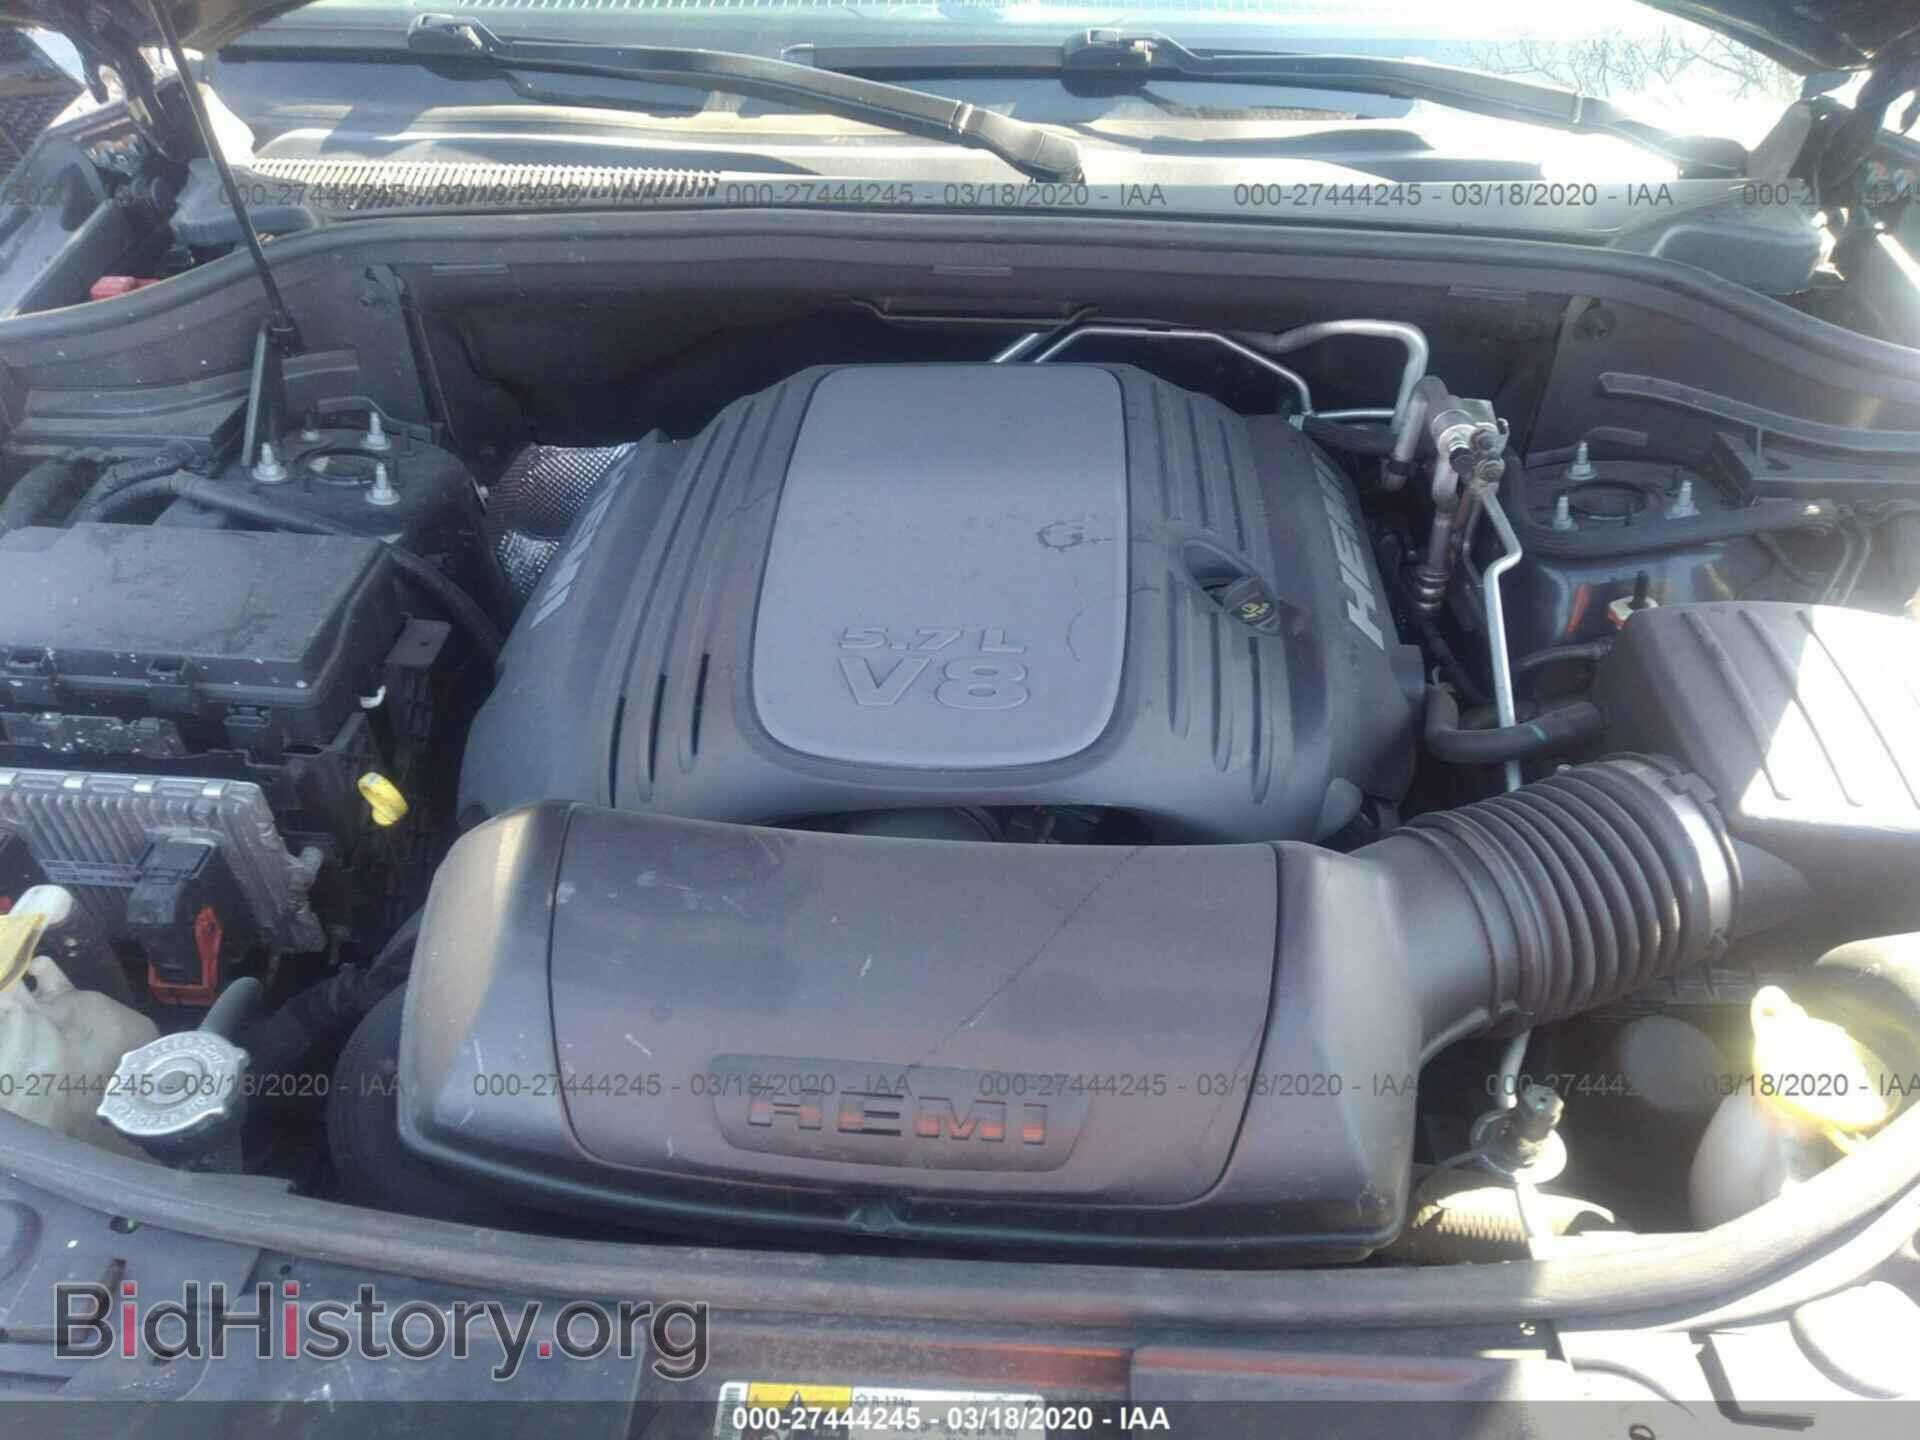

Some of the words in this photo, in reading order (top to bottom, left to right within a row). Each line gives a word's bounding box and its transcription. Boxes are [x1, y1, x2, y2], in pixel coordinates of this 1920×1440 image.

[1311, 452, 1384, 651] HEMI
[837, 656, 1030, 710] V8
[747, 1086, 1048, 1145] HEMI
